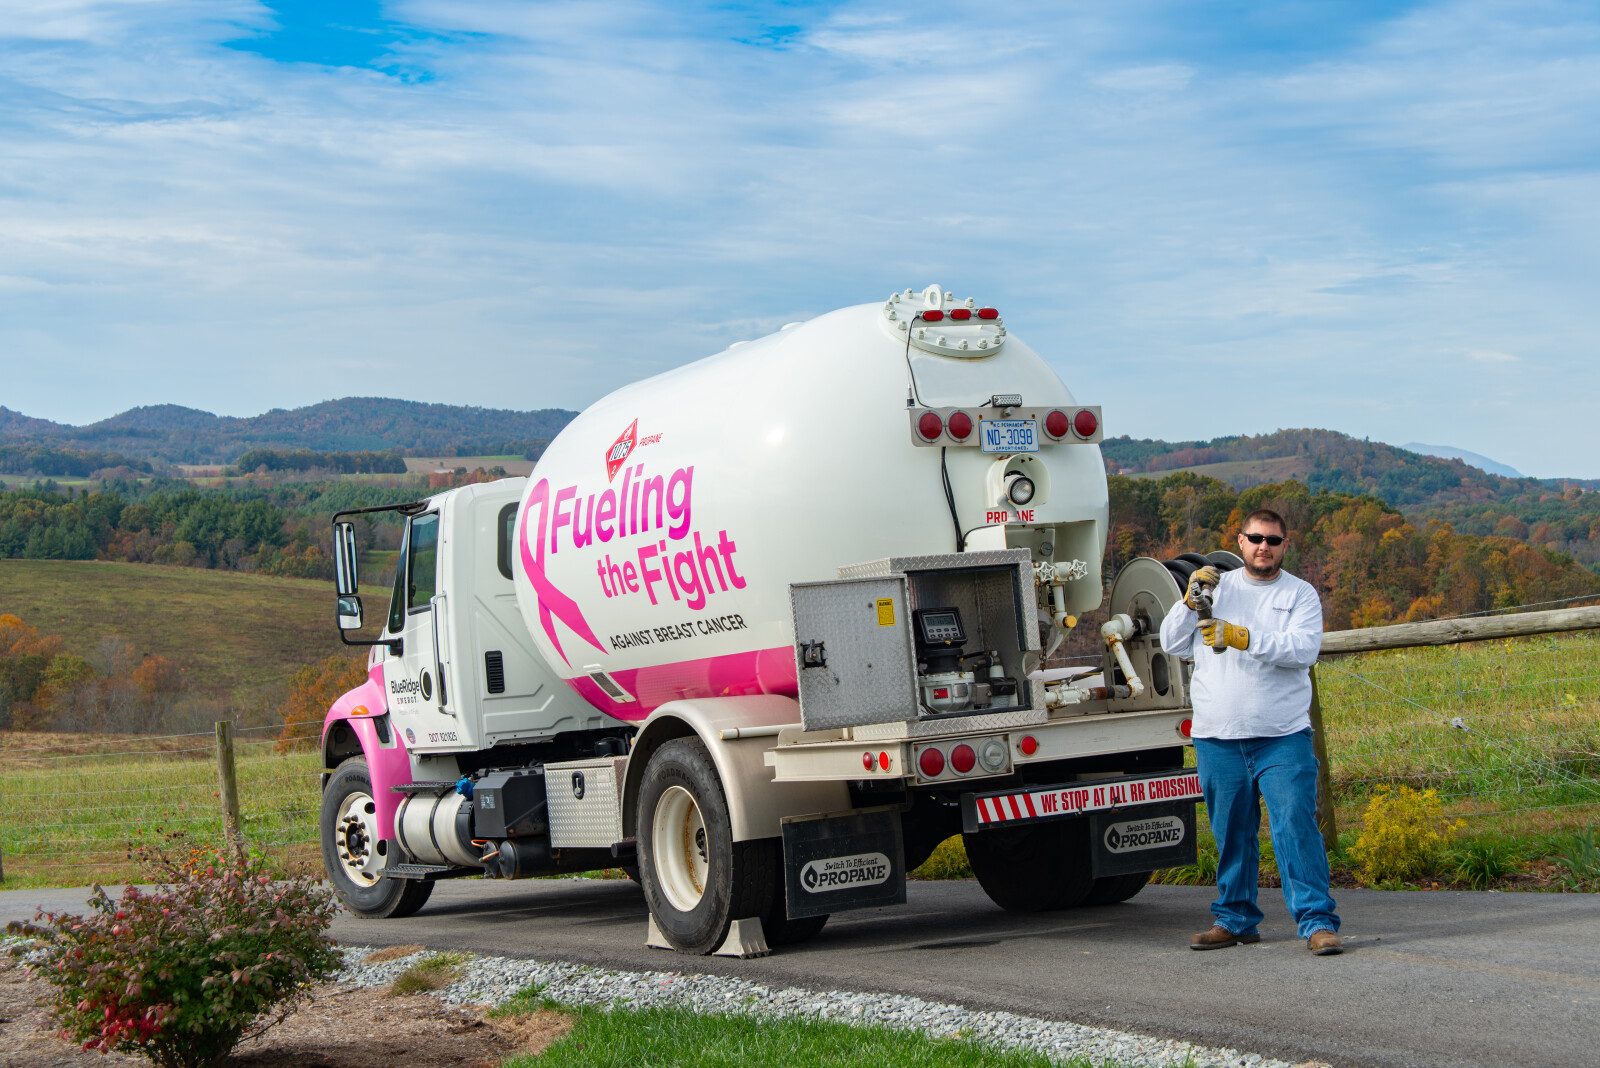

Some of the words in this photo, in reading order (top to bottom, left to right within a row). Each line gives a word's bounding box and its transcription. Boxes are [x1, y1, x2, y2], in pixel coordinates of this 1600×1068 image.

[610, 440, 632, 461] 1075
[639, 433, 663, 447] PROPANE
[551, 463, 694, 554] Fueling
[597, 554, 640, 598] the
[637, 530, 747, 611] Fight
[609, 630, 655, 650] AGAINST
[652, 622, 695, 643] BREAST
[698, 614, 748, 634] CANCER
[390, 678, 420, 695] BlueRidge
[1041, 793, 1058, 813] WE
[1061, 790, 1089, 811] STOP
[1093, 787, 1106, 807] AT
[1109, 784, 1128, 805] ALL
[1130, 782, 1146, 802] RR
[1125, 824, 1144, 833] Switch
[1145, 823, 1151, 831] To
[1151, 821, 1174, 830] Efficient
[1120, 828, 1181, 848] PROPANE
[824, 862, 845, 871] Switch
[845, 860, 853, 868] To
[852, 857, 879, 867] Efficient
[818, 865, 886, 887] PROPANE
